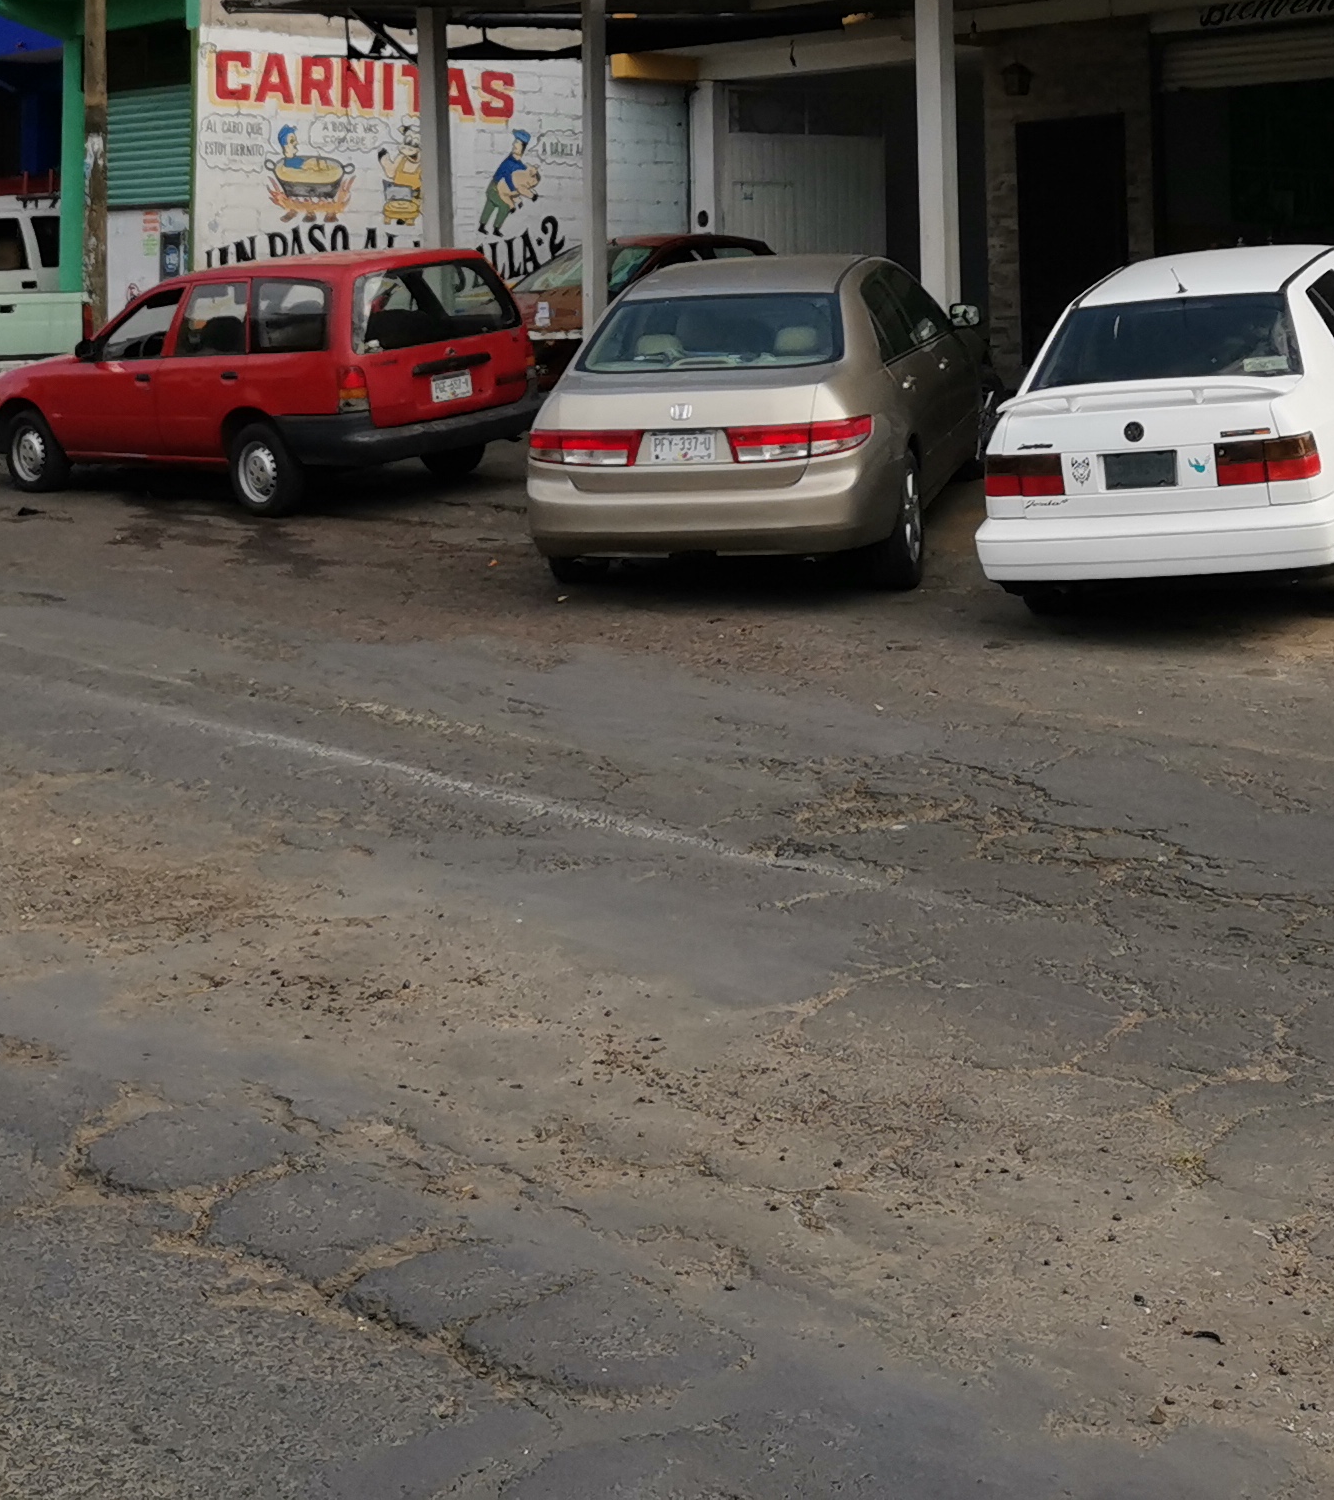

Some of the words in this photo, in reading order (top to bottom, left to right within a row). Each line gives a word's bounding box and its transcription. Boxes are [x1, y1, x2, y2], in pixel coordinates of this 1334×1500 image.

[214, 50, 515, 120] CARNITAS
[265, 223, 350, 258] PASO
[653, 436, 711, 453] PFY-337-U
